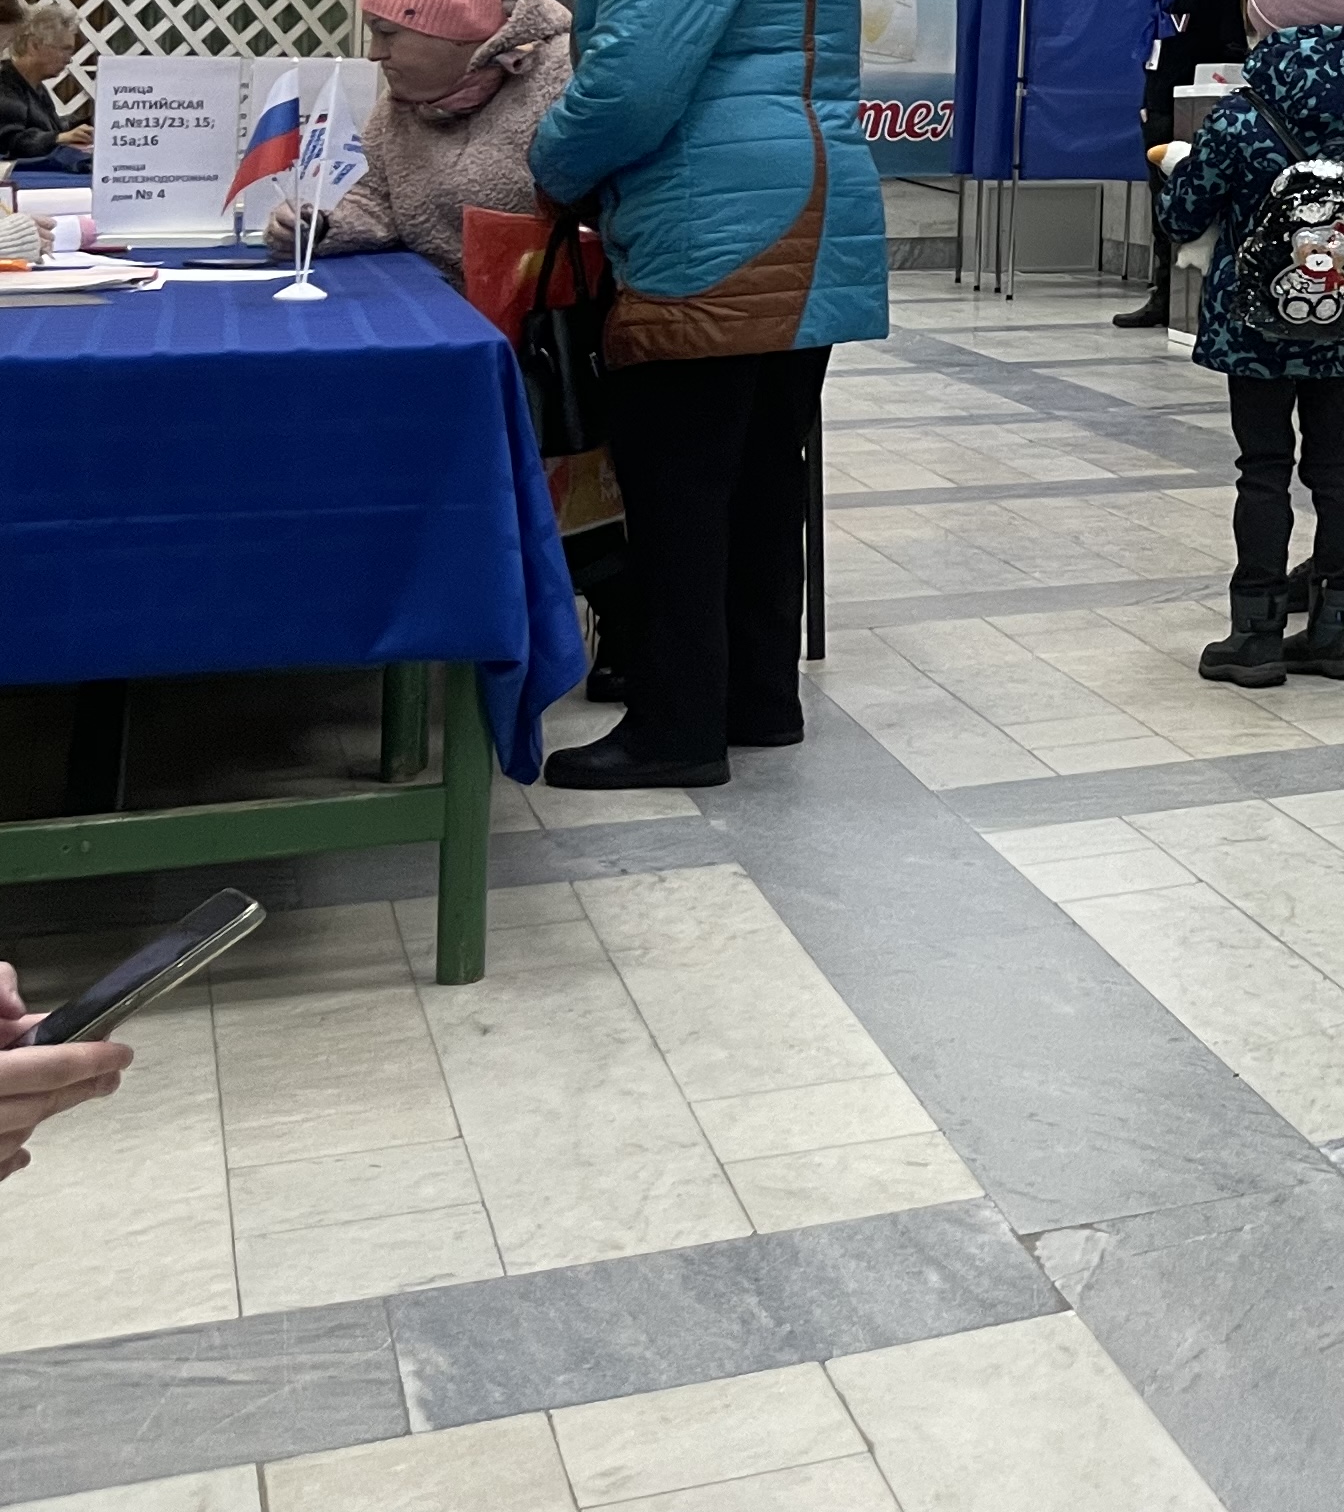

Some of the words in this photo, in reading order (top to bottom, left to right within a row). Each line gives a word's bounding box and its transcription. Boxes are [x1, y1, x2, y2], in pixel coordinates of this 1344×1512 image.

[113, 85, 153, 95] улица
[112, 97, 204, 110] БАЛТИЙСКАЯ
[194, 116, 215, 129] 15;
[112, 135, 159, 147] 15а;16
[157, 189, 166, 199] 4
